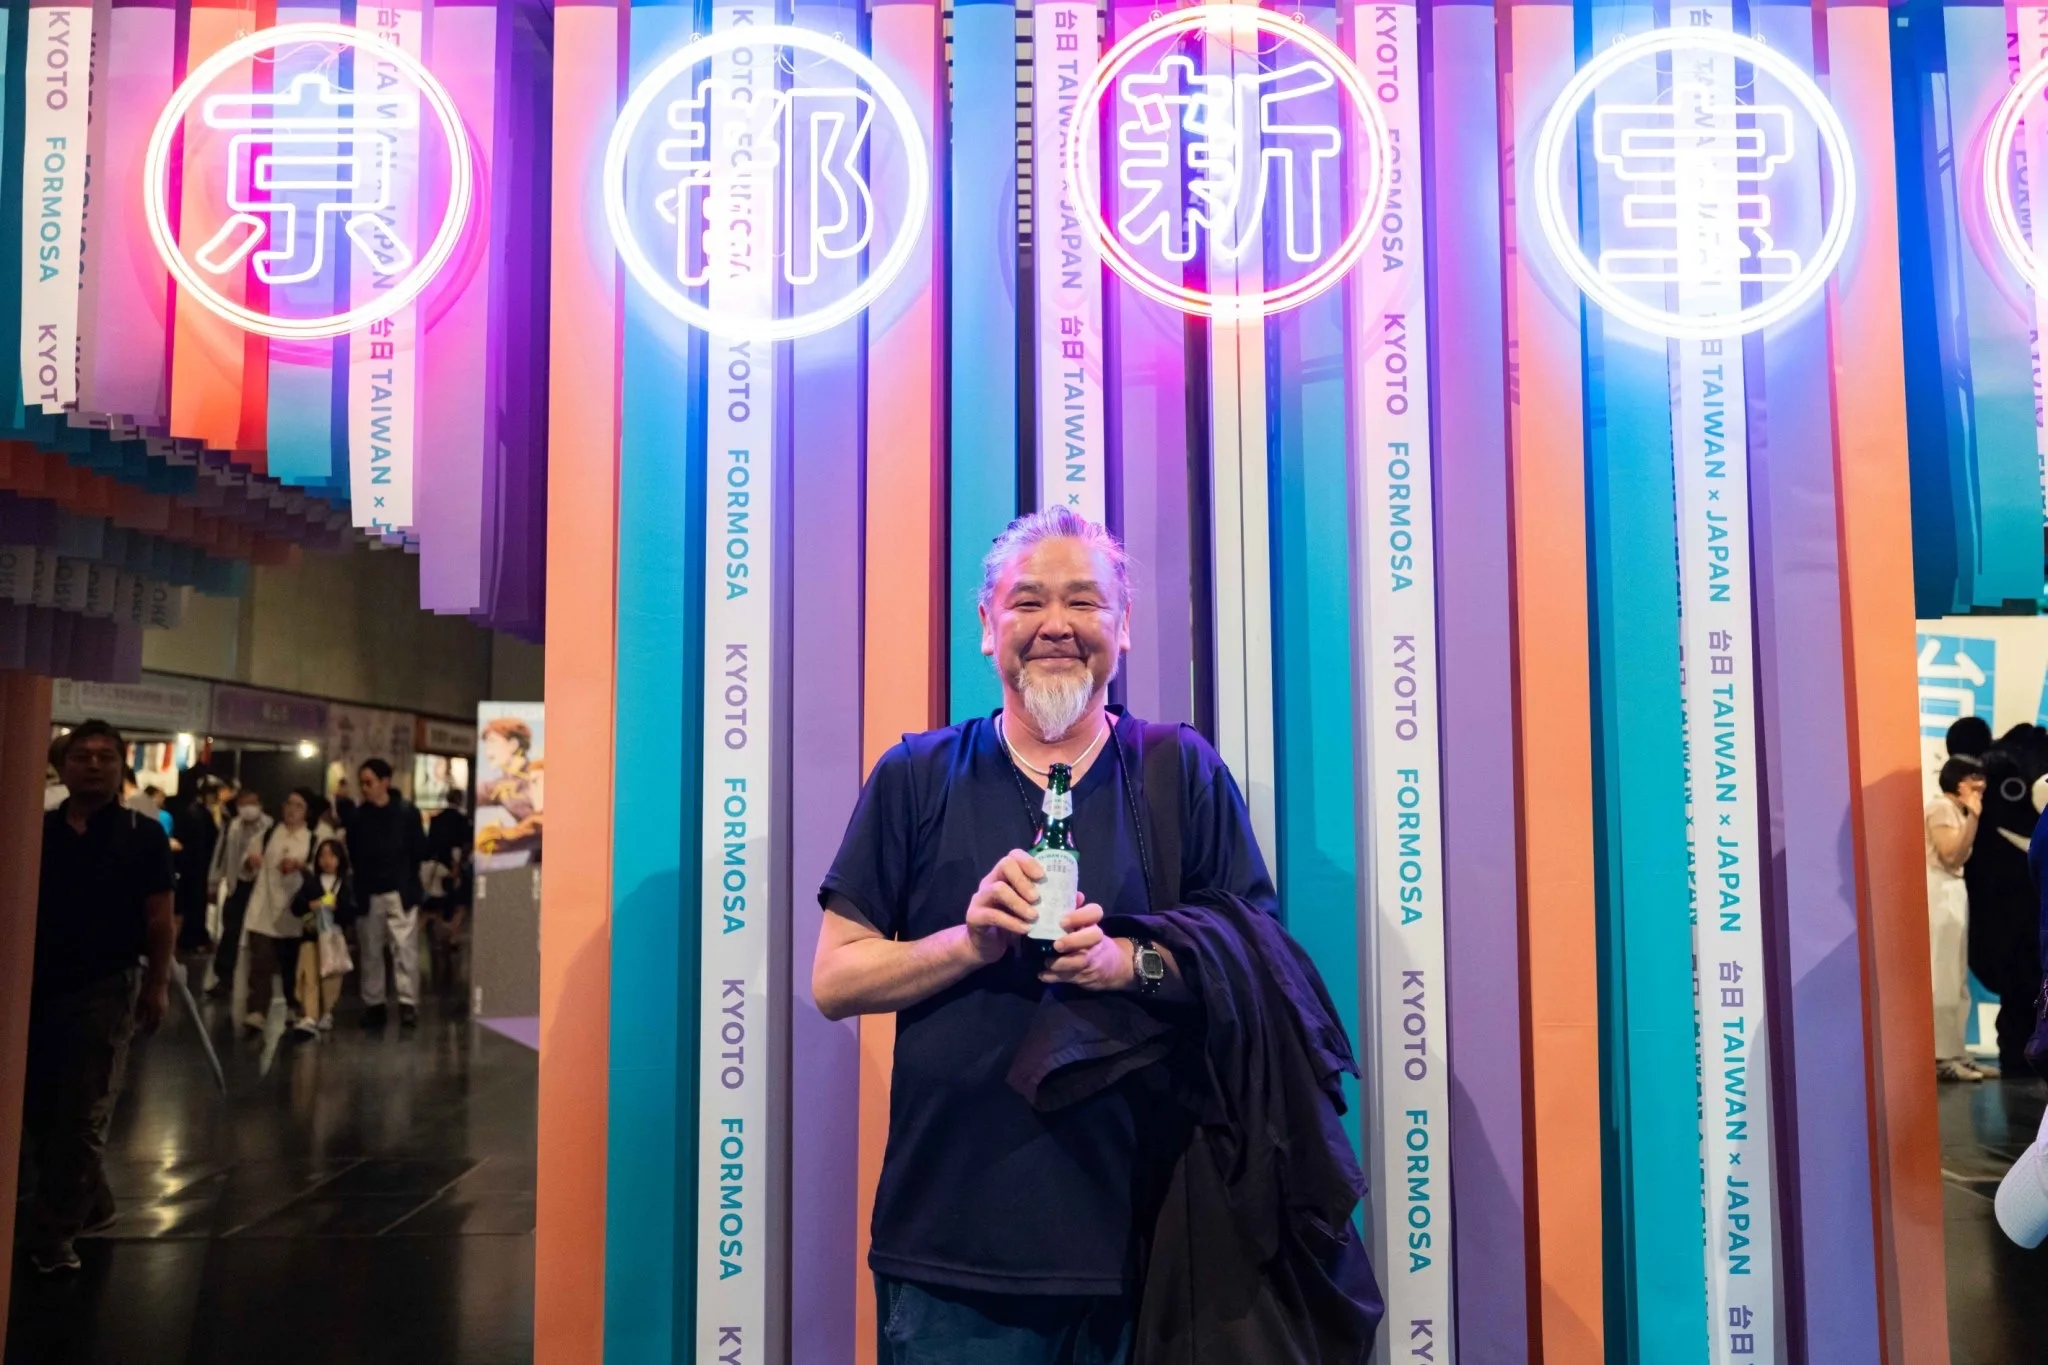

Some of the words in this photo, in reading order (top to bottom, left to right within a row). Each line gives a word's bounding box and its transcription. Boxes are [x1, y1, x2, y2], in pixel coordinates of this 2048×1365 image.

[46, 11, 70, 110] KYOTO
[731, 9, 754, 104] KOTO
[1055, 10, 1078, 51] 台日
[1376, 7, 1399, 103] KYOTO
[40, 138, 66, 282] FORMOSA
[195, 73, 417, 285] 京
[655, 78, 876, 287] 都
[1118, 56, 1342, 262] 新
[1060, 200, 1082, 288] JAPAN
[37, 325, 58, 403] KYOT
[728, 342, 750, 422] YOTO
[1061, 316, 1084, 359] 台日
[1384, 314, 1408, 415] KYOTO
[371, 369, 392, 484] TAIWAN
[1062, 368, 1086, 481] TAIWAN
[1703, 366, 1725, 478] TAIWAN
[727, 450, 749, 600] FORMOSA
[1389, 443, 1412, 592] FORMOSA
[1706, 511, 1730, 601] JAPAN
[725, 644, 747, 749] KYOTO
[1394, 636, 1417, 741] KYOTO
[1709, 630, 1733, 674] 台日
[1713, 684, 1736, 801] TAIWAN
[723, 779, 746, 934] FORMOSA
[1398, 769, 1422, 925] FORMOSA
[1717, 836, 1741, 931] JAPAN
[721, 980, 744, 1089] KYOTO
[1403, 971, 1427, 1081] KYOTO
[1719, 961, 1743, 1007] 台日
[1723, 1017, 1747, 1140] TAIWAN
[720, 1119, 743, 1280] FORMOSA
[1406, 1111, 1431, 1273] FORMOSA
[1727, 1176, 1750, 1274] JAPAN
[1729, 1305, 1754, 1354] 台日
